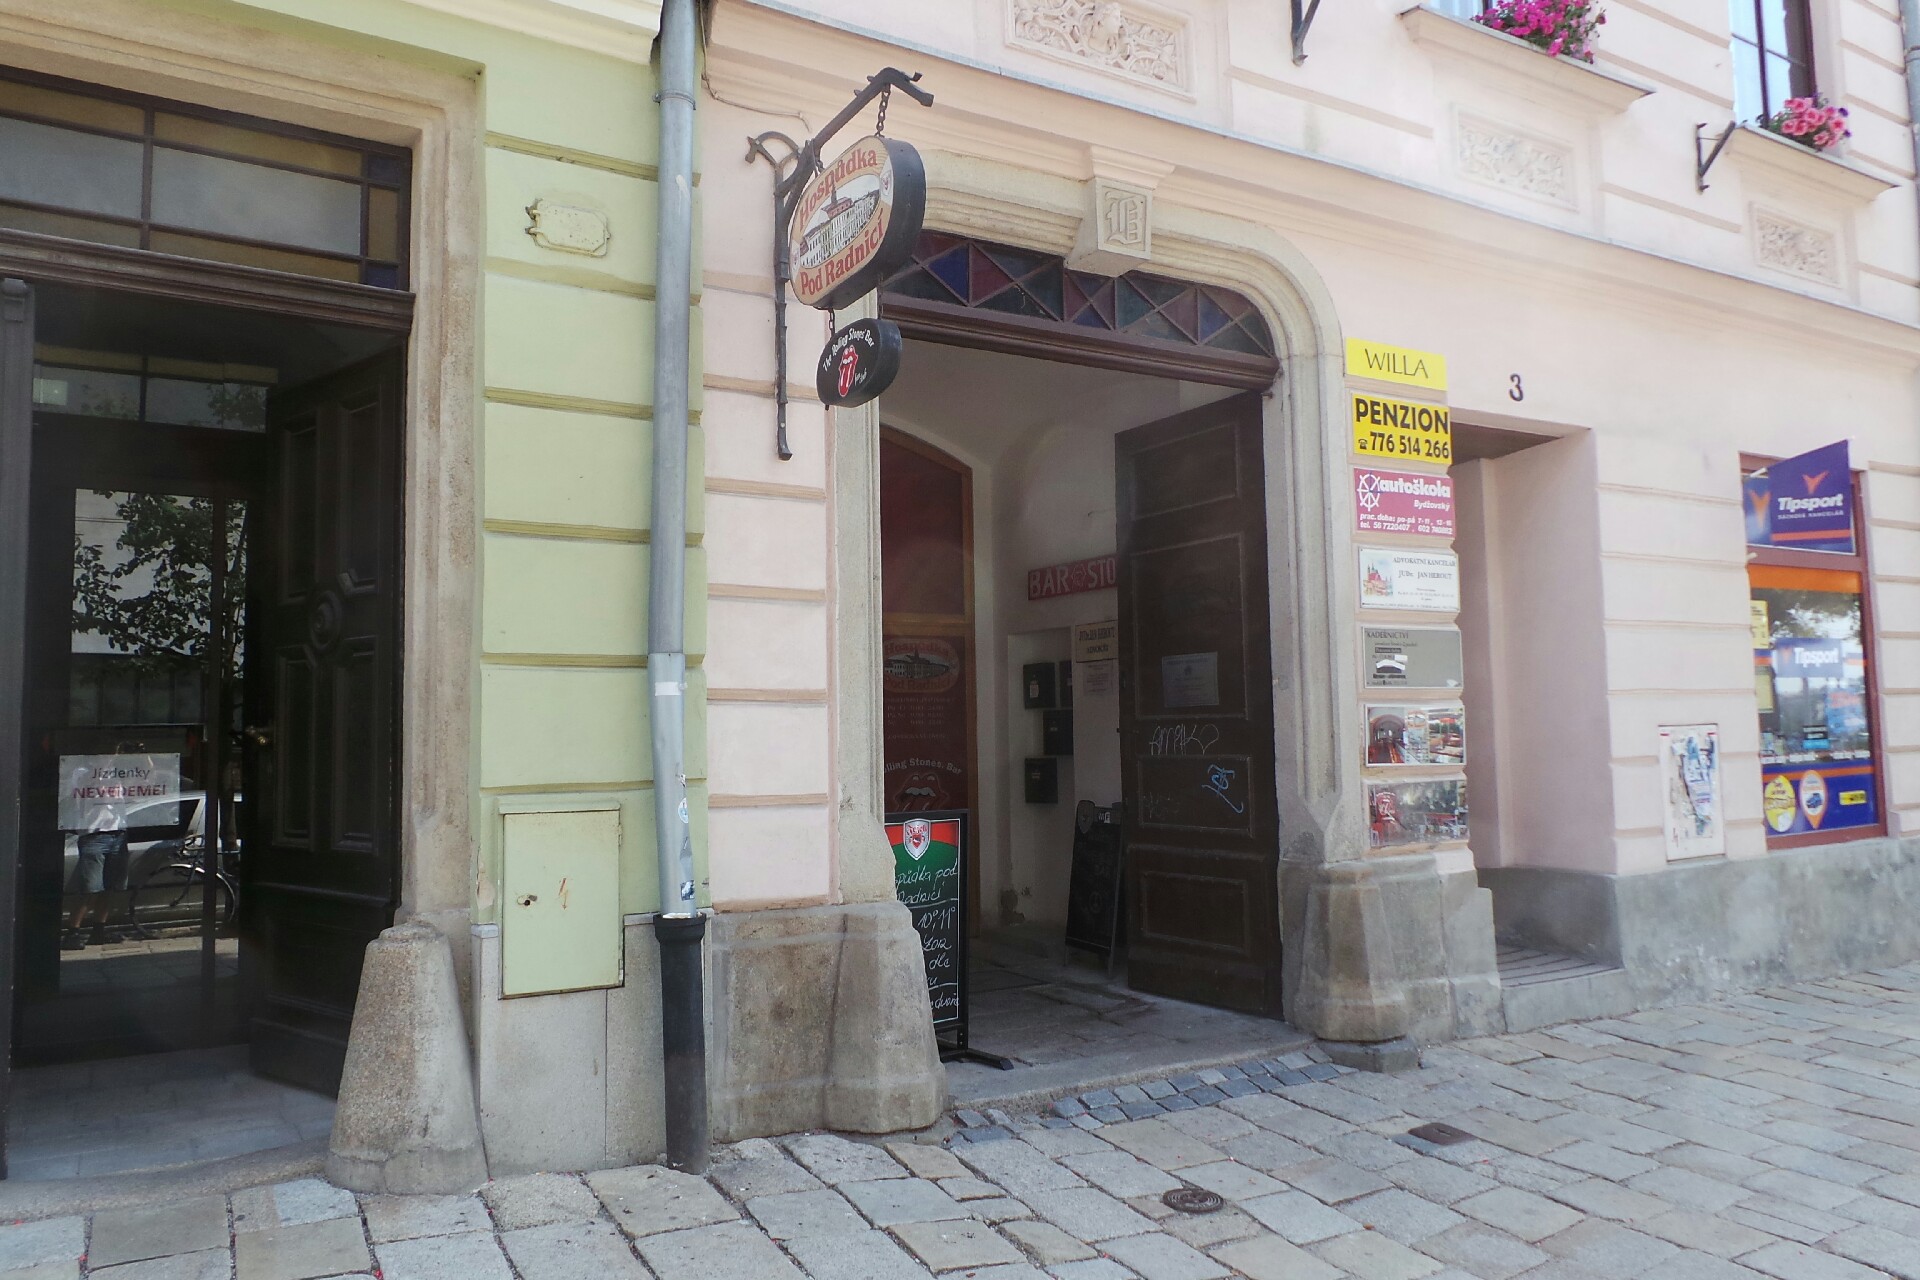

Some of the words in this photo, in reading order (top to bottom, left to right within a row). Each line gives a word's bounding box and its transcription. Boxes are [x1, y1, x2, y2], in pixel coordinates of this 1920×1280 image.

[800, 267, 823, 296] Pod
[824, 208, 884, 287] Radnicí
[1364, 347, 1429, 379] WILLA
[1508, 373, 1524, 402] 3
[1355, 397, 1448, 435] PENZION
[1369, 431, 1395, 453] 776
[1399, 434, 1421, 456] 514
[1424, 438, 1450, 459] 266
[1379, 477, 1451, 498] autoškola
[1413, 499, 1451, 512] Bydžovský
[1777, 493, 1844, 513] Tipsport
[1359, 520, 1371, 528] tel.
[1360, 512, 1377, 521] prac.
[1029, 567, 1070, 599] BAR
[1794, 647, 1839, 668] Tipsport
[91, 766, 151, 780] Jízdenky
